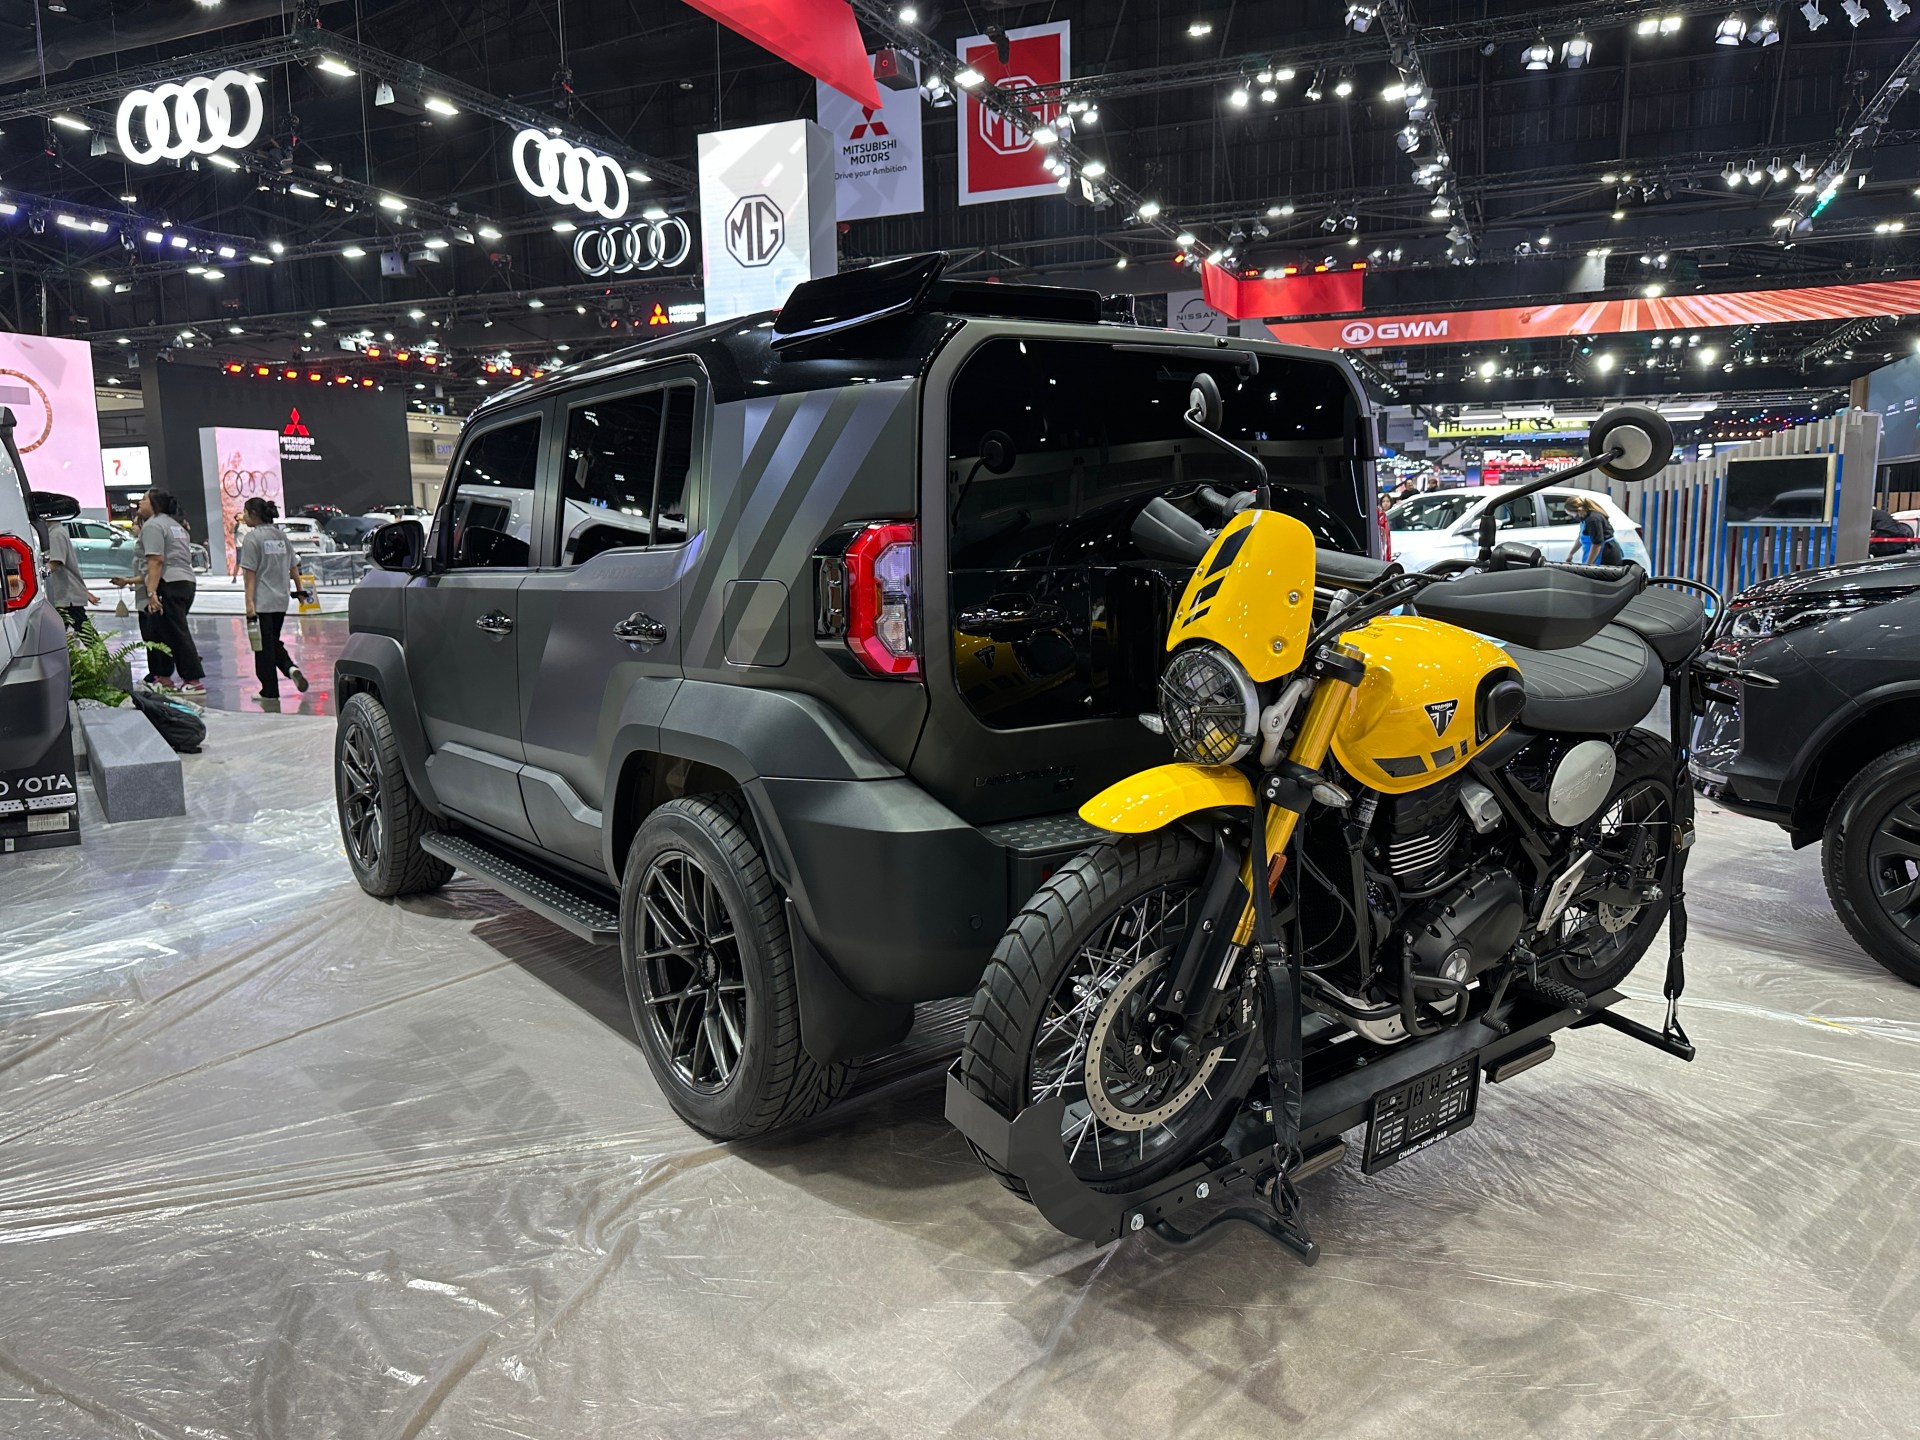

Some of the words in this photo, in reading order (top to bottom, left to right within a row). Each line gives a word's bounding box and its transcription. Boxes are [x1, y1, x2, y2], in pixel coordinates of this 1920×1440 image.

[843, 139, 897, 155] MITSUBISHI
[850, 151, 890, 166] MOTORS
[834, 170, 854, 181] Drive
[854, 169, 872, 180] your
[872, 164, 907, 176] Ambition
[731, 202, 778, 261] MG
[1176, 310, 1218, 322] NISSAN
[1376, 319, 1449, 340] GWM
[280, 436, 315, 446] MITSUBISHI
[285, 444, 311, 452] MOTORS
